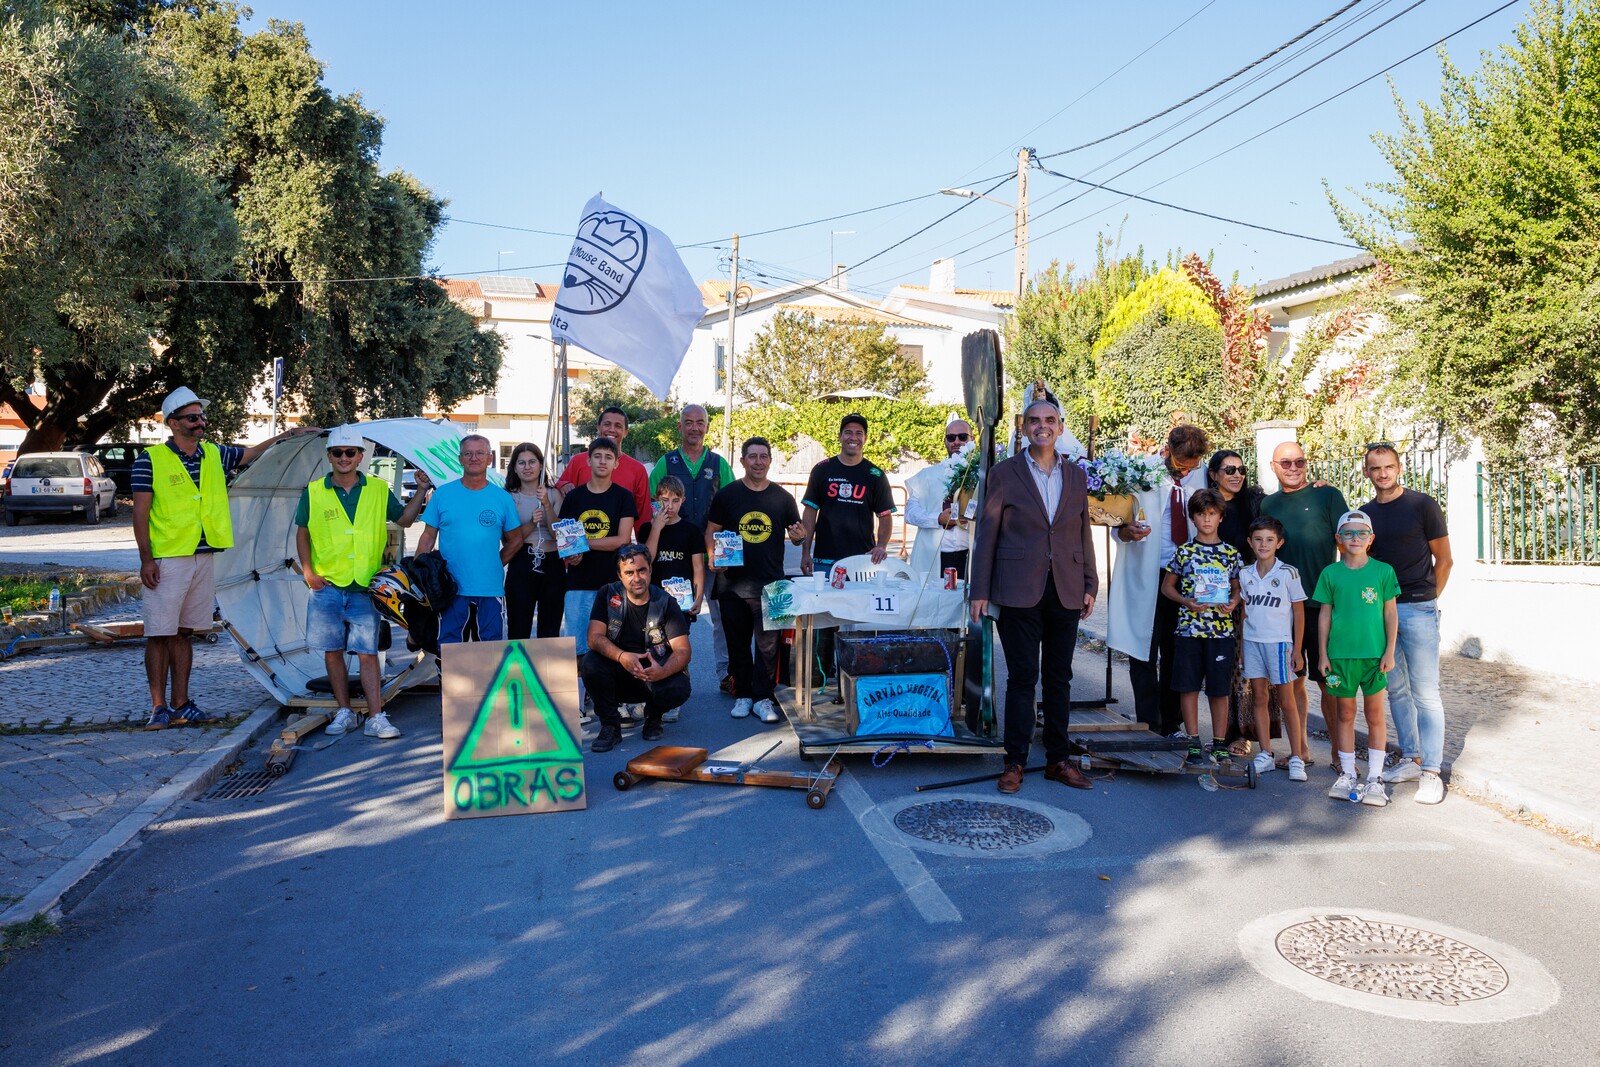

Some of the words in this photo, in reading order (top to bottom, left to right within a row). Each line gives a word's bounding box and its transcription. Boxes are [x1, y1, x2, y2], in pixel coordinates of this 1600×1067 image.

[575, 246, 598, 266] Mouse
[597, 260, 625, 284] Band
[550, 314, 569, 331] ita
[584, 522, 610, 530] MANUS
[715, 531, 735, 539] moita
[875, 597, 895, 611] 11
[863, 682, 904, 707] CARVÃO
[906, 683, 945, 704] VEGETAL
[892, 708, 932, 718] Qualidade
[453, 767, 584, 812] OBRAS
